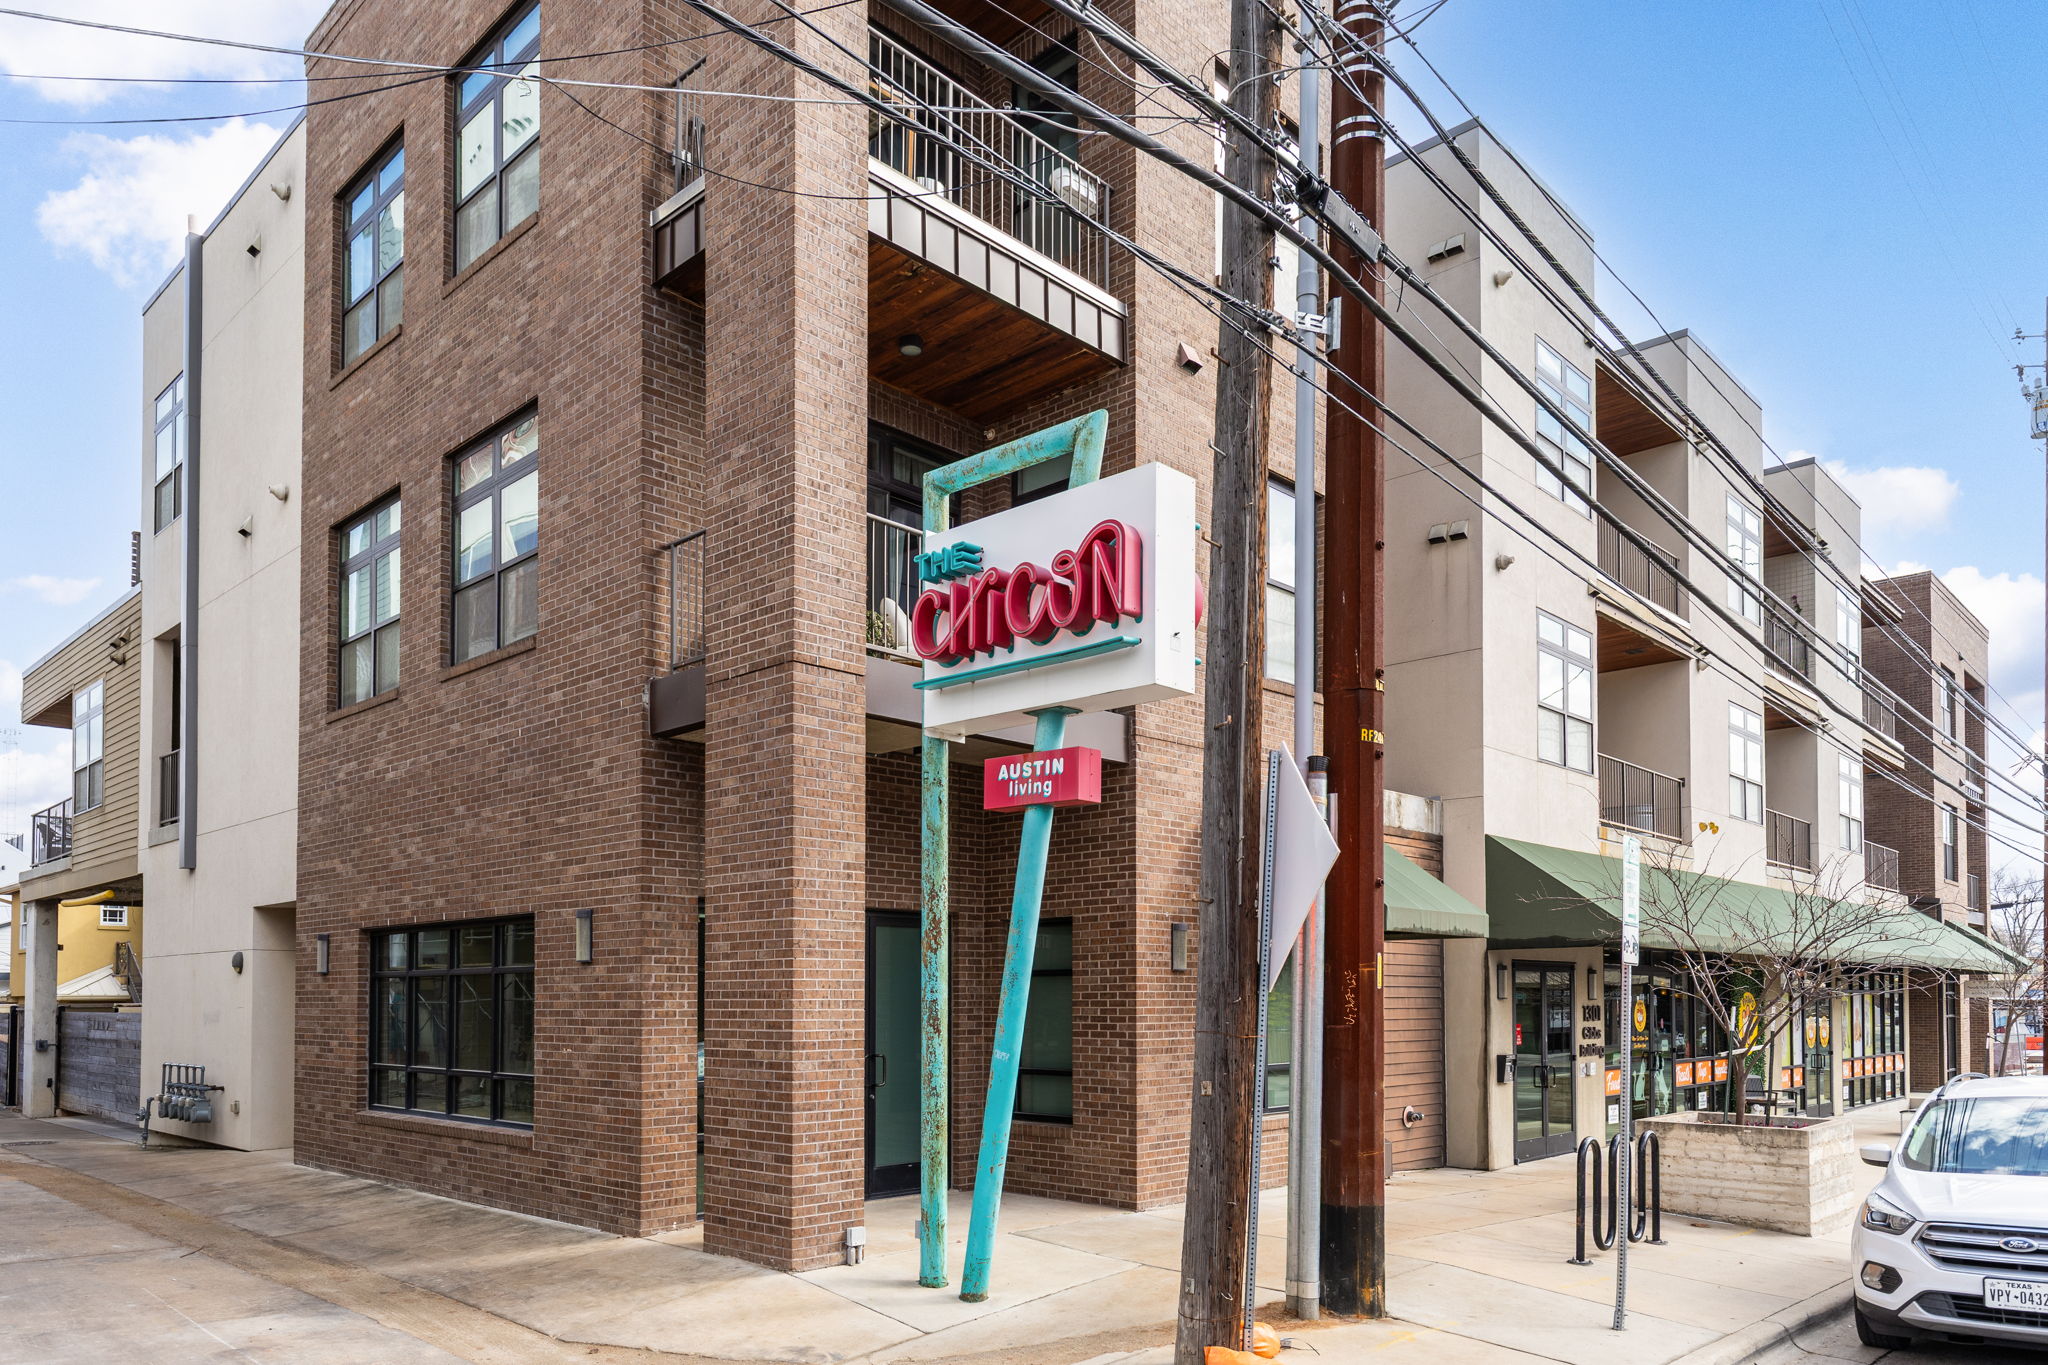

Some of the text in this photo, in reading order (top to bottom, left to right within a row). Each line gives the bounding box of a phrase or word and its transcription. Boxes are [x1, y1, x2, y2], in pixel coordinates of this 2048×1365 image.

[913, 540, 984, 584] THE
[998, 757, 1064, 781] AUSTIN
[1009, 779, 1052, 798] living
[2008, 1240, 2029, 1249] Ford
